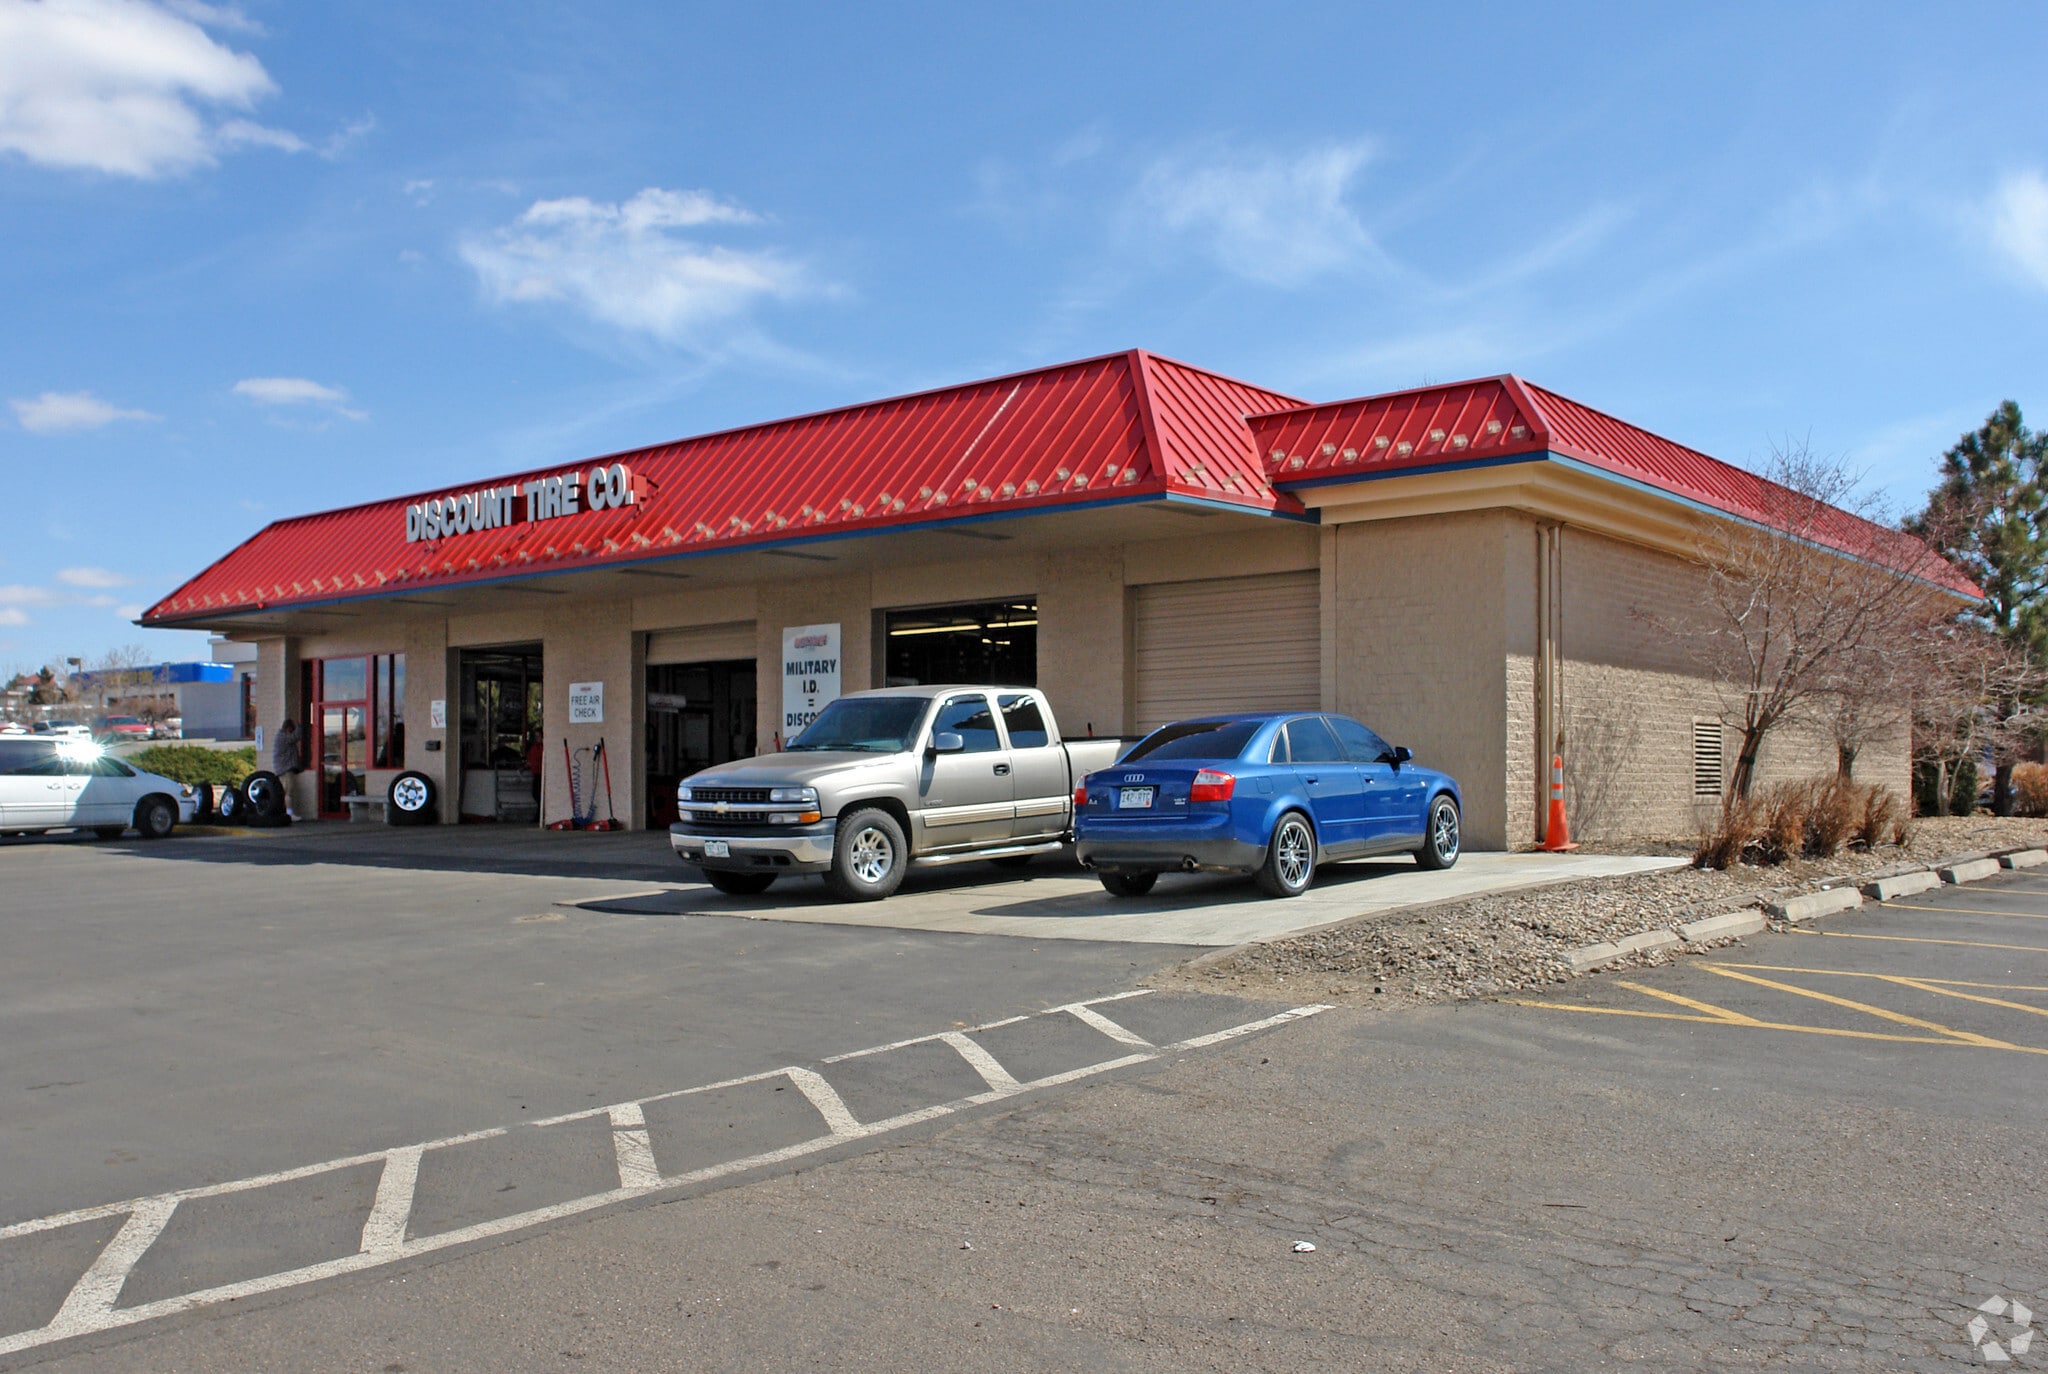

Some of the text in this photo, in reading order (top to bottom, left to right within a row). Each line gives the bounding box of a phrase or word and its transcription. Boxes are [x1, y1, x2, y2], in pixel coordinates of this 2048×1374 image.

[406, 463, 634, 543] DISCOUNT TIRE CO.
[786, 659, 837, 676] MILITARY
[803, 680, 820, 694] I.D.
[570, 694, 600, 706] FREE AIR
[575, 707, 597, 718] CHECK
[786, 711, 818, 727] DISCO
